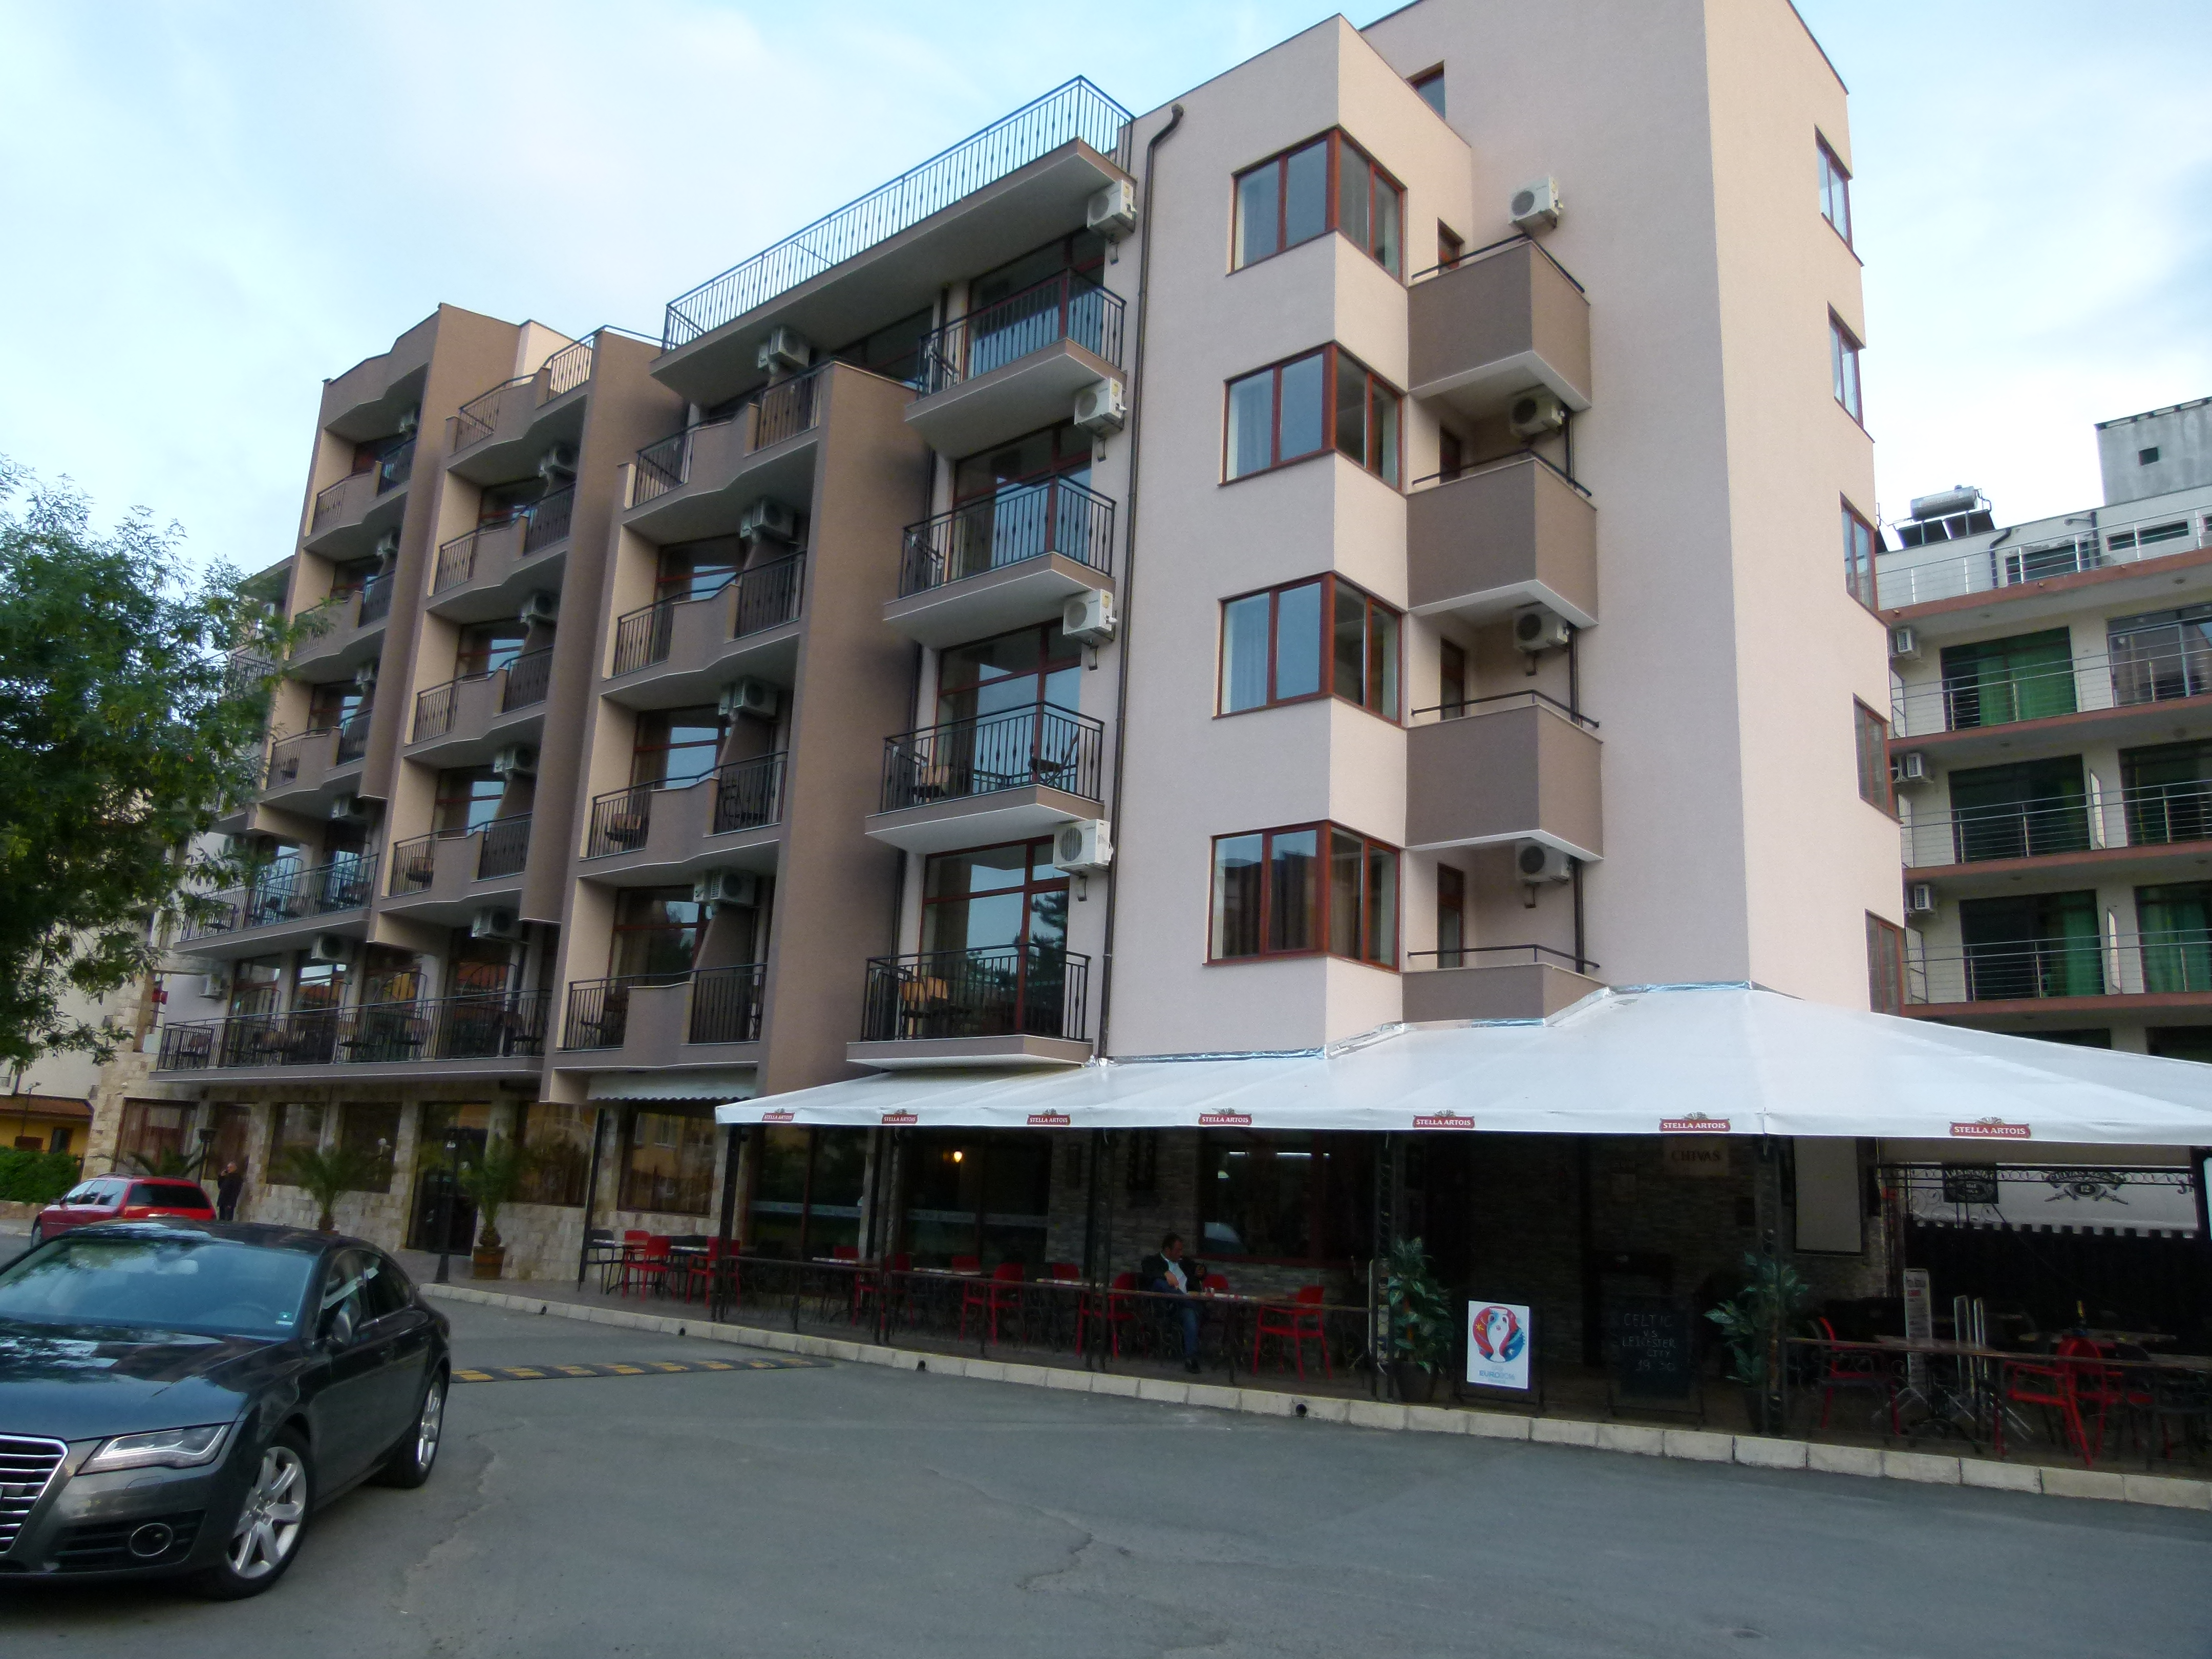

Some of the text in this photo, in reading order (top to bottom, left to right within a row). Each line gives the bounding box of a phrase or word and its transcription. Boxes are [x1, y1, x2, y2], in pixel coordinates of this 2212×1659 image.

[1624, 1312, 1673, 1327] CELTIC
[1622, 1335, 1676, 1349] LEICESTER
[1647, 1348, 1670, 1357] CITY
